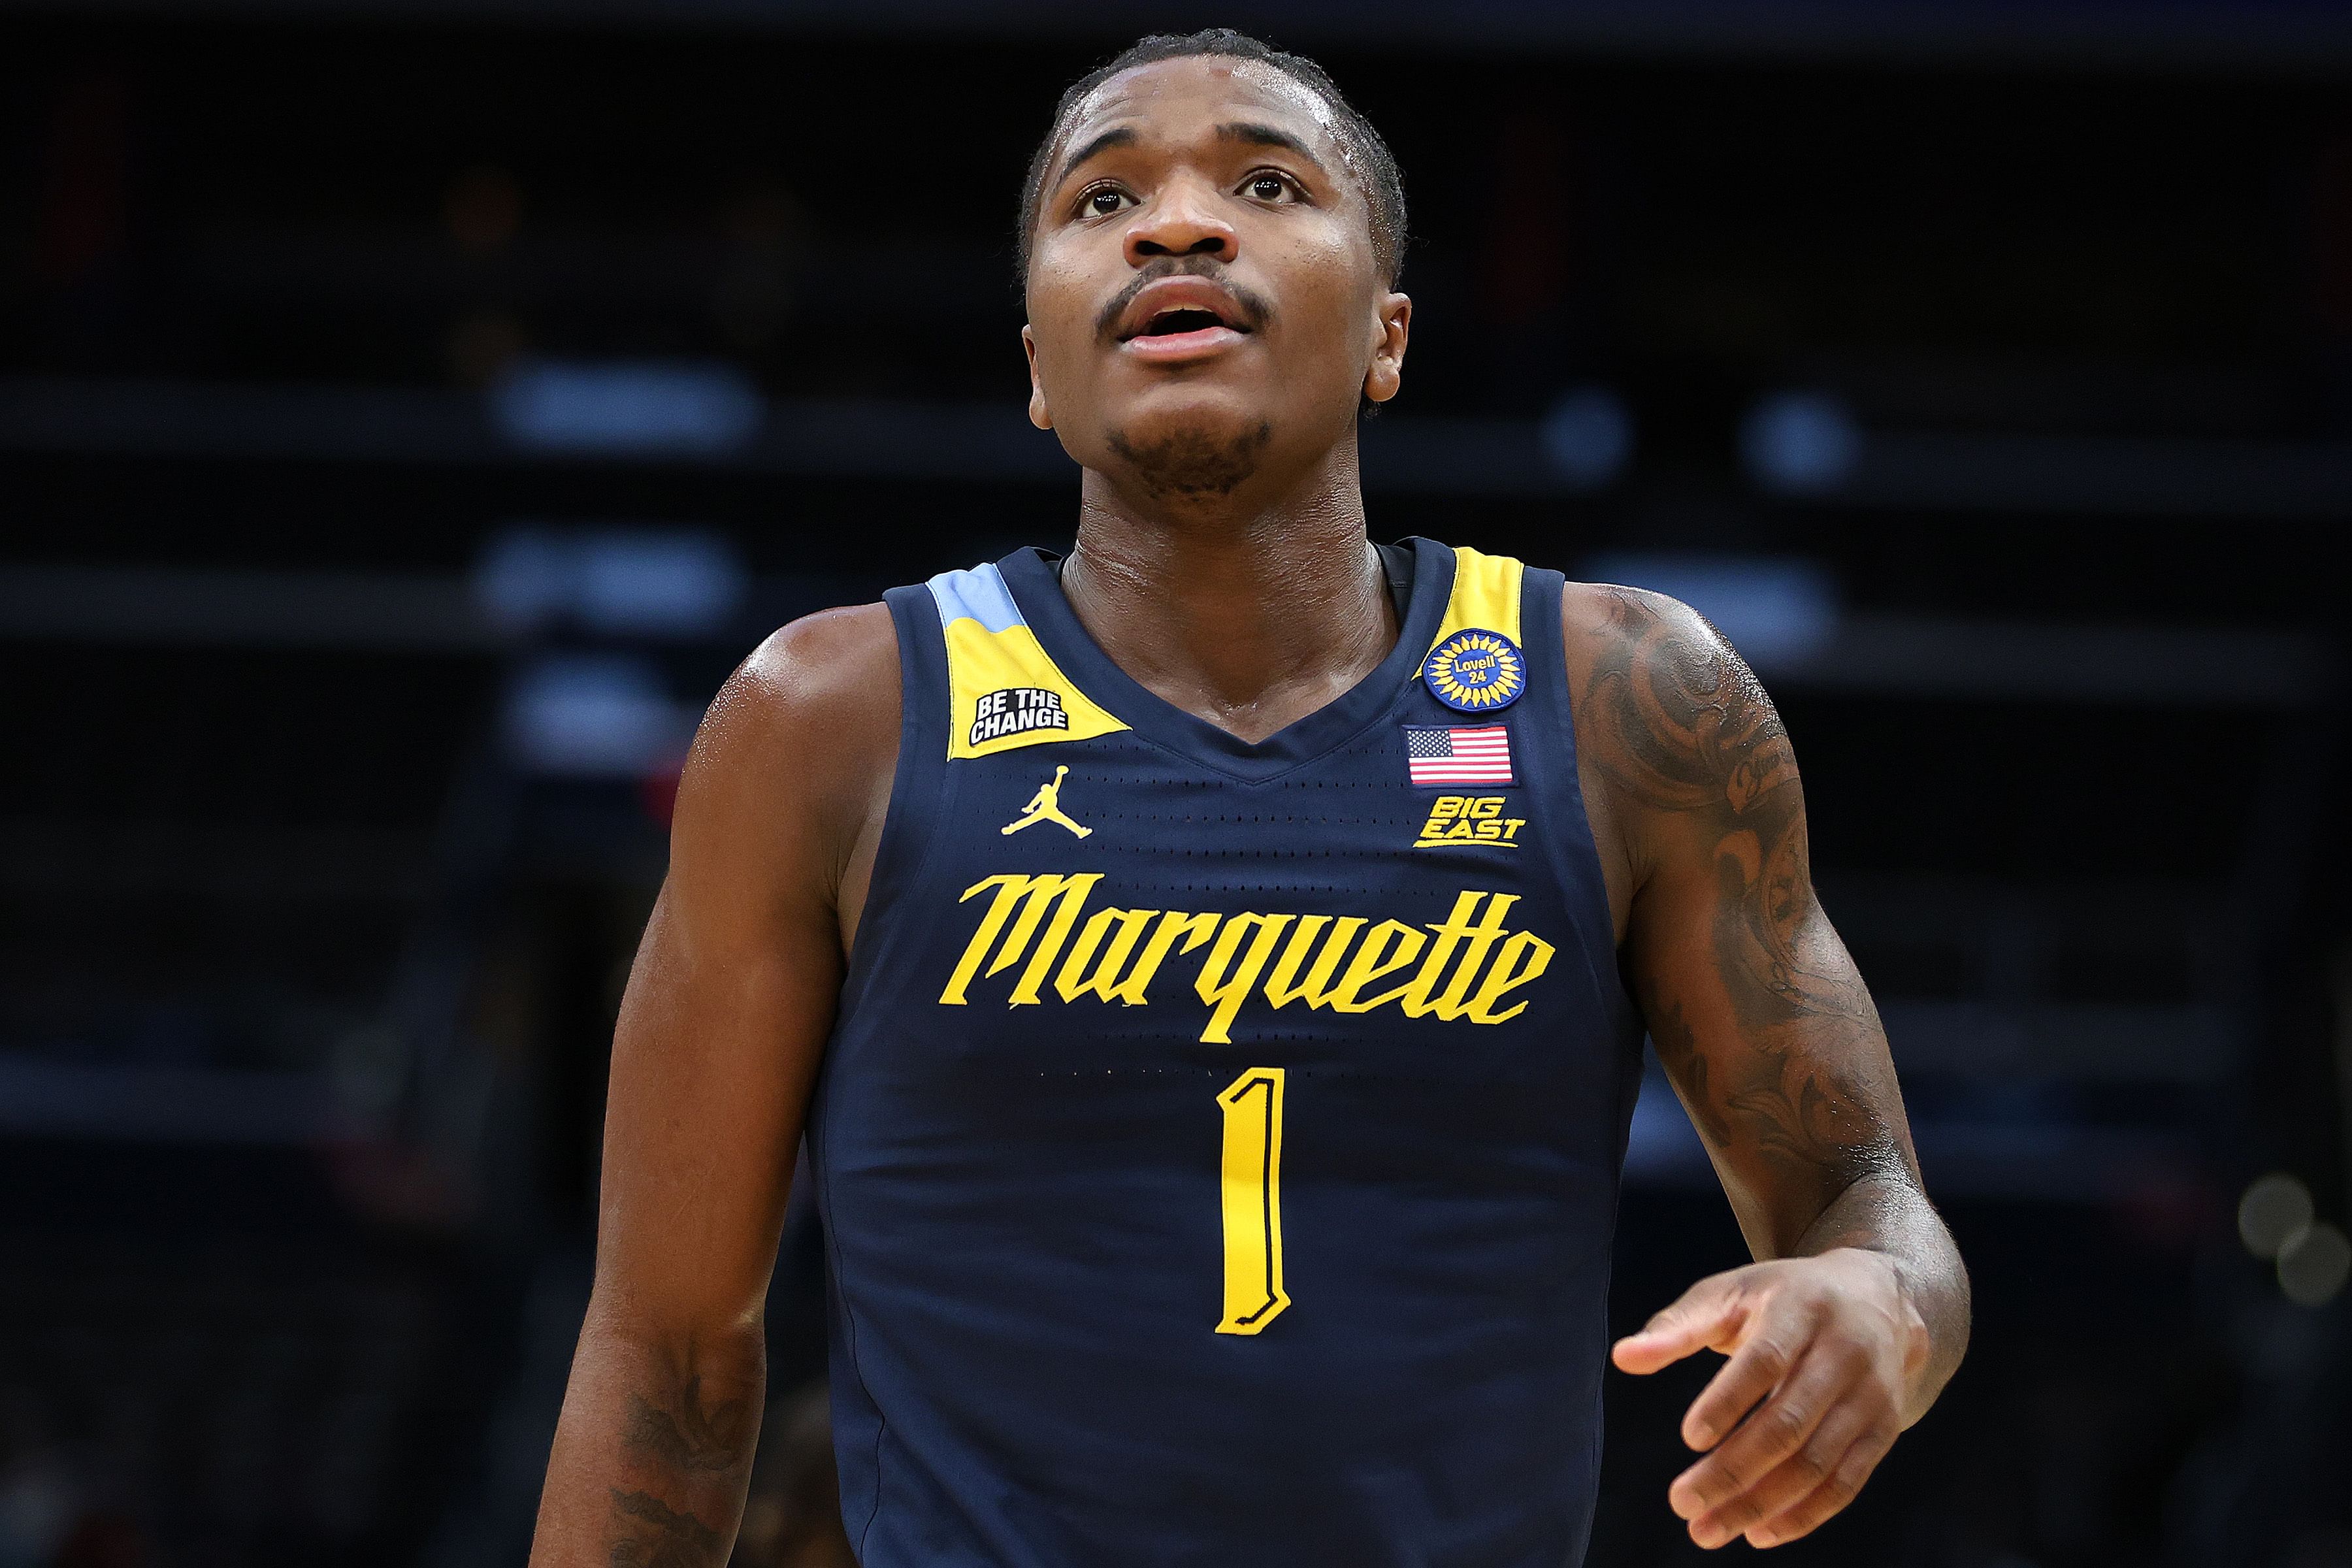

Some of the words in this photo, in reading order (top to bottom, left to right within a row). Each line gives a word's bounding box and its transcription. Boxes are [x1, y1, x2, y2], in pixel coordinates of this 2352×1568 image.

[1454, 655, 1495, 673] Lovell
[1469, 670, 1487, 684] 24
[977, 691, 1007, 720] BE
[1015, 689, 1060, 710] THE
[970, 708, 1067, 745] CHANGE
[1429, 796, 1506, 819] BIG
[1420, 819, 1526, 840] EAST
[939, 873, 1556, 1045] Marquette
[1215, 1067, 1291, 1335] 1
